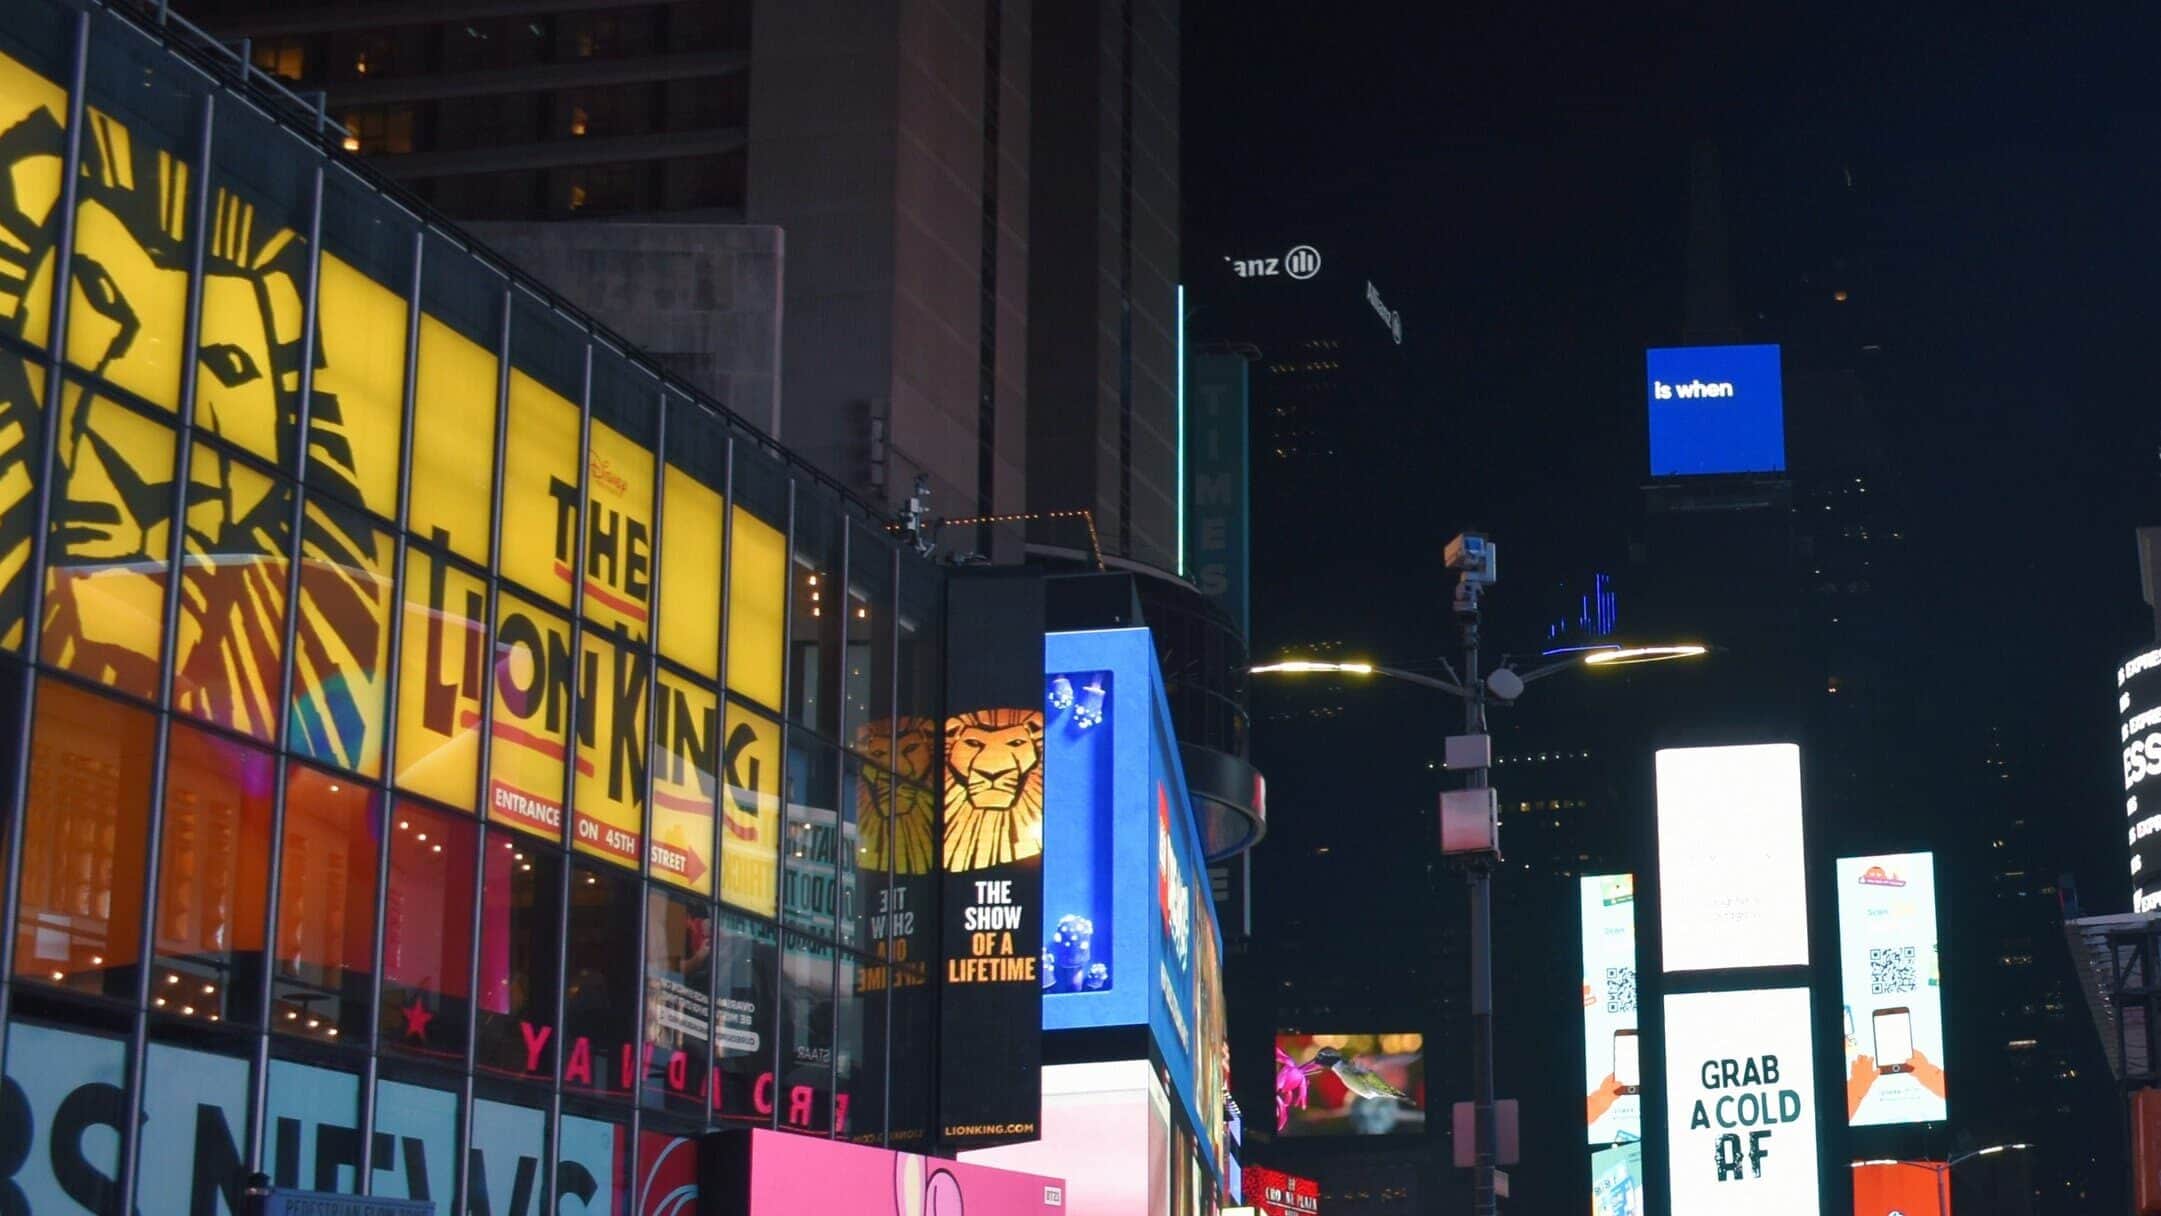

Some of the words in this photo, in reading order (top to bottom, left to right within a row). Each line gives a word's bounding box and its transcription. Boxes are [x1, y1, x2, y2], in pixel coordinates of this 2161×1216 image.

[1225, 257, 1280, 278] anz
[1675, 379, 1734, 398] when
[1195, 383, 1234, 595] TIMES
[548, 474, 649, 602] THE
[423, 525, 599, 749] LION
[607, 620, 762, 819] KING
[495, 788, 560, 828] ENTRANCE
[578, 819, 599, 841] ON
[604, 831, 636, 855] 45TH
[650, 846, 686, 873] STREET
[974, 880, 1012, 905] THE
[964, 906, 1022, 931] SHOW
[972, 933, 996, 956] OF
[999, 932, 1013, 956] A
[949, 957, 1036, 984] LIFETIME
[1701, 1055, 1779, 1089] GRAB
[1690, 1099, 1711, 1130] A
[1715, 1089, 1801, 1129] COLD
[945, 1123, 1034, 1137] LIONKING.COM
[1714, 1129, 1772, 1182] AF
